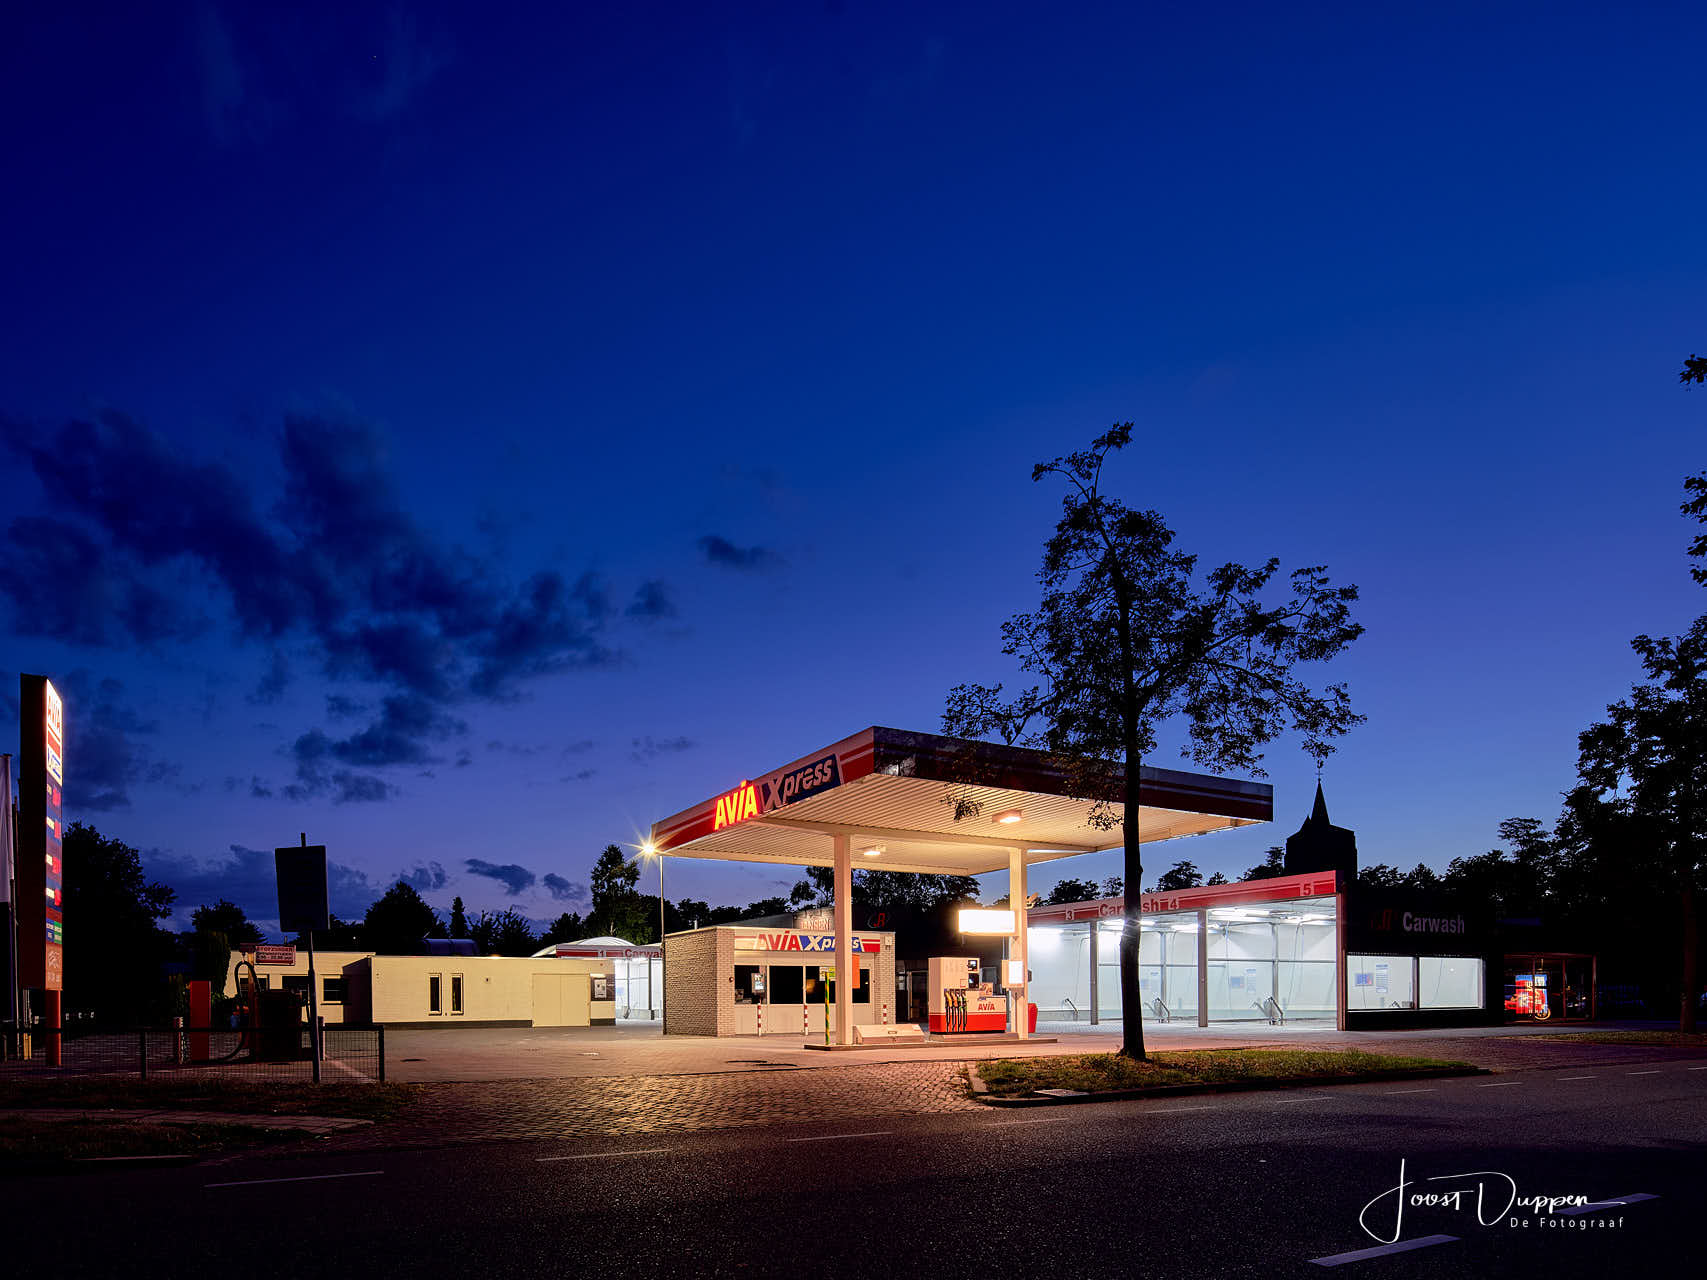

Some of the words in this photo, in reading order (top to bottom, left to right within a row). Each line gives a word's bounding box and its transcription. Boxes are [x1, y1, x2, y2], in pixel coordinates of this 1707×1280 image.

[714, 781, 760, 832] AVIA
[765, 759, 836, 812] Xpress
[1066, 909, 1073, 921] 3
[1100, 898, 1160, 917] Carsh
[1169, 898, 1178, 909] 4
[1303, 884, 1312, 896] 5
[1402, 911, 1465, 934] Carwash
[755, 930, 802, 951] AVIA
[803, 935, 860, 951] Xprs
[977, 1002, 996, 1011] AVIA
